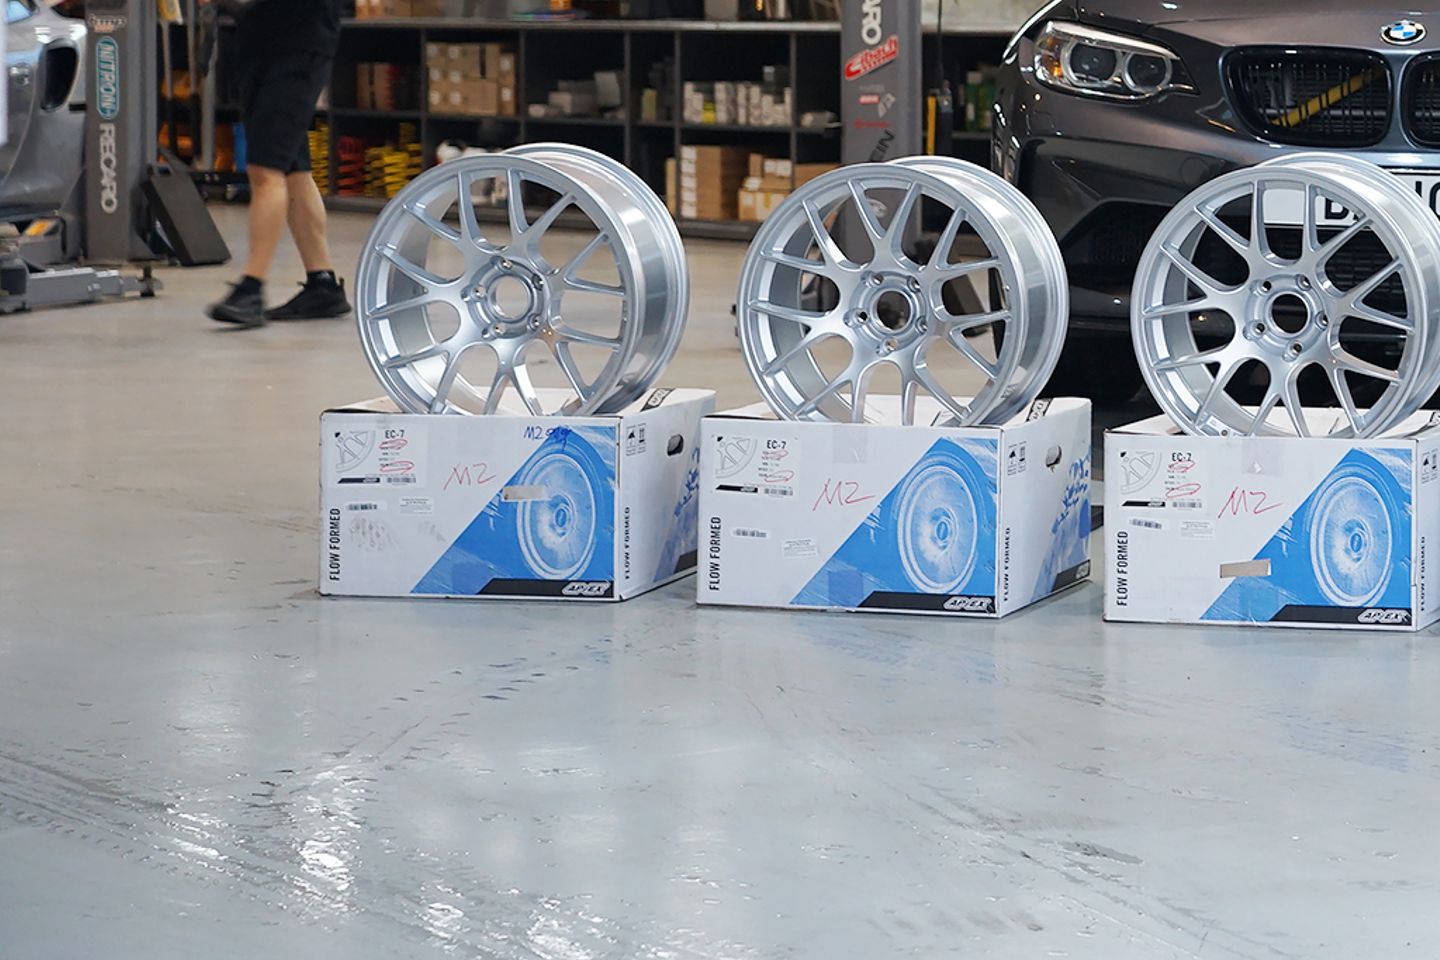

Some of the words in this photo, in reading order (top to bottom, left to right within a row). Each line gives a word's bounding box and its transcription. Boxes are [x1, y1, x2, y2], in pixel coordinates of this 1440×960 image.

[100, 123, 118, 214] RECARO
[385, 429, 405, 439] EC-7
[766, 439, 787, 450] EC-7
[444, 462, 496, 490] M2
[812, 478, 875, 511] M2
[1218, 486, 1283, 519] M2
[329, 508, 341, 550] FORMED
[709, 516, 722, 559] FORMED
[329, 553, 341, 581] FLOW
[1117, 531, 1129, 575] FORMED
[709, 561, 720, 591] FLOW
[1116, 578, 1128, 606] FLOW
